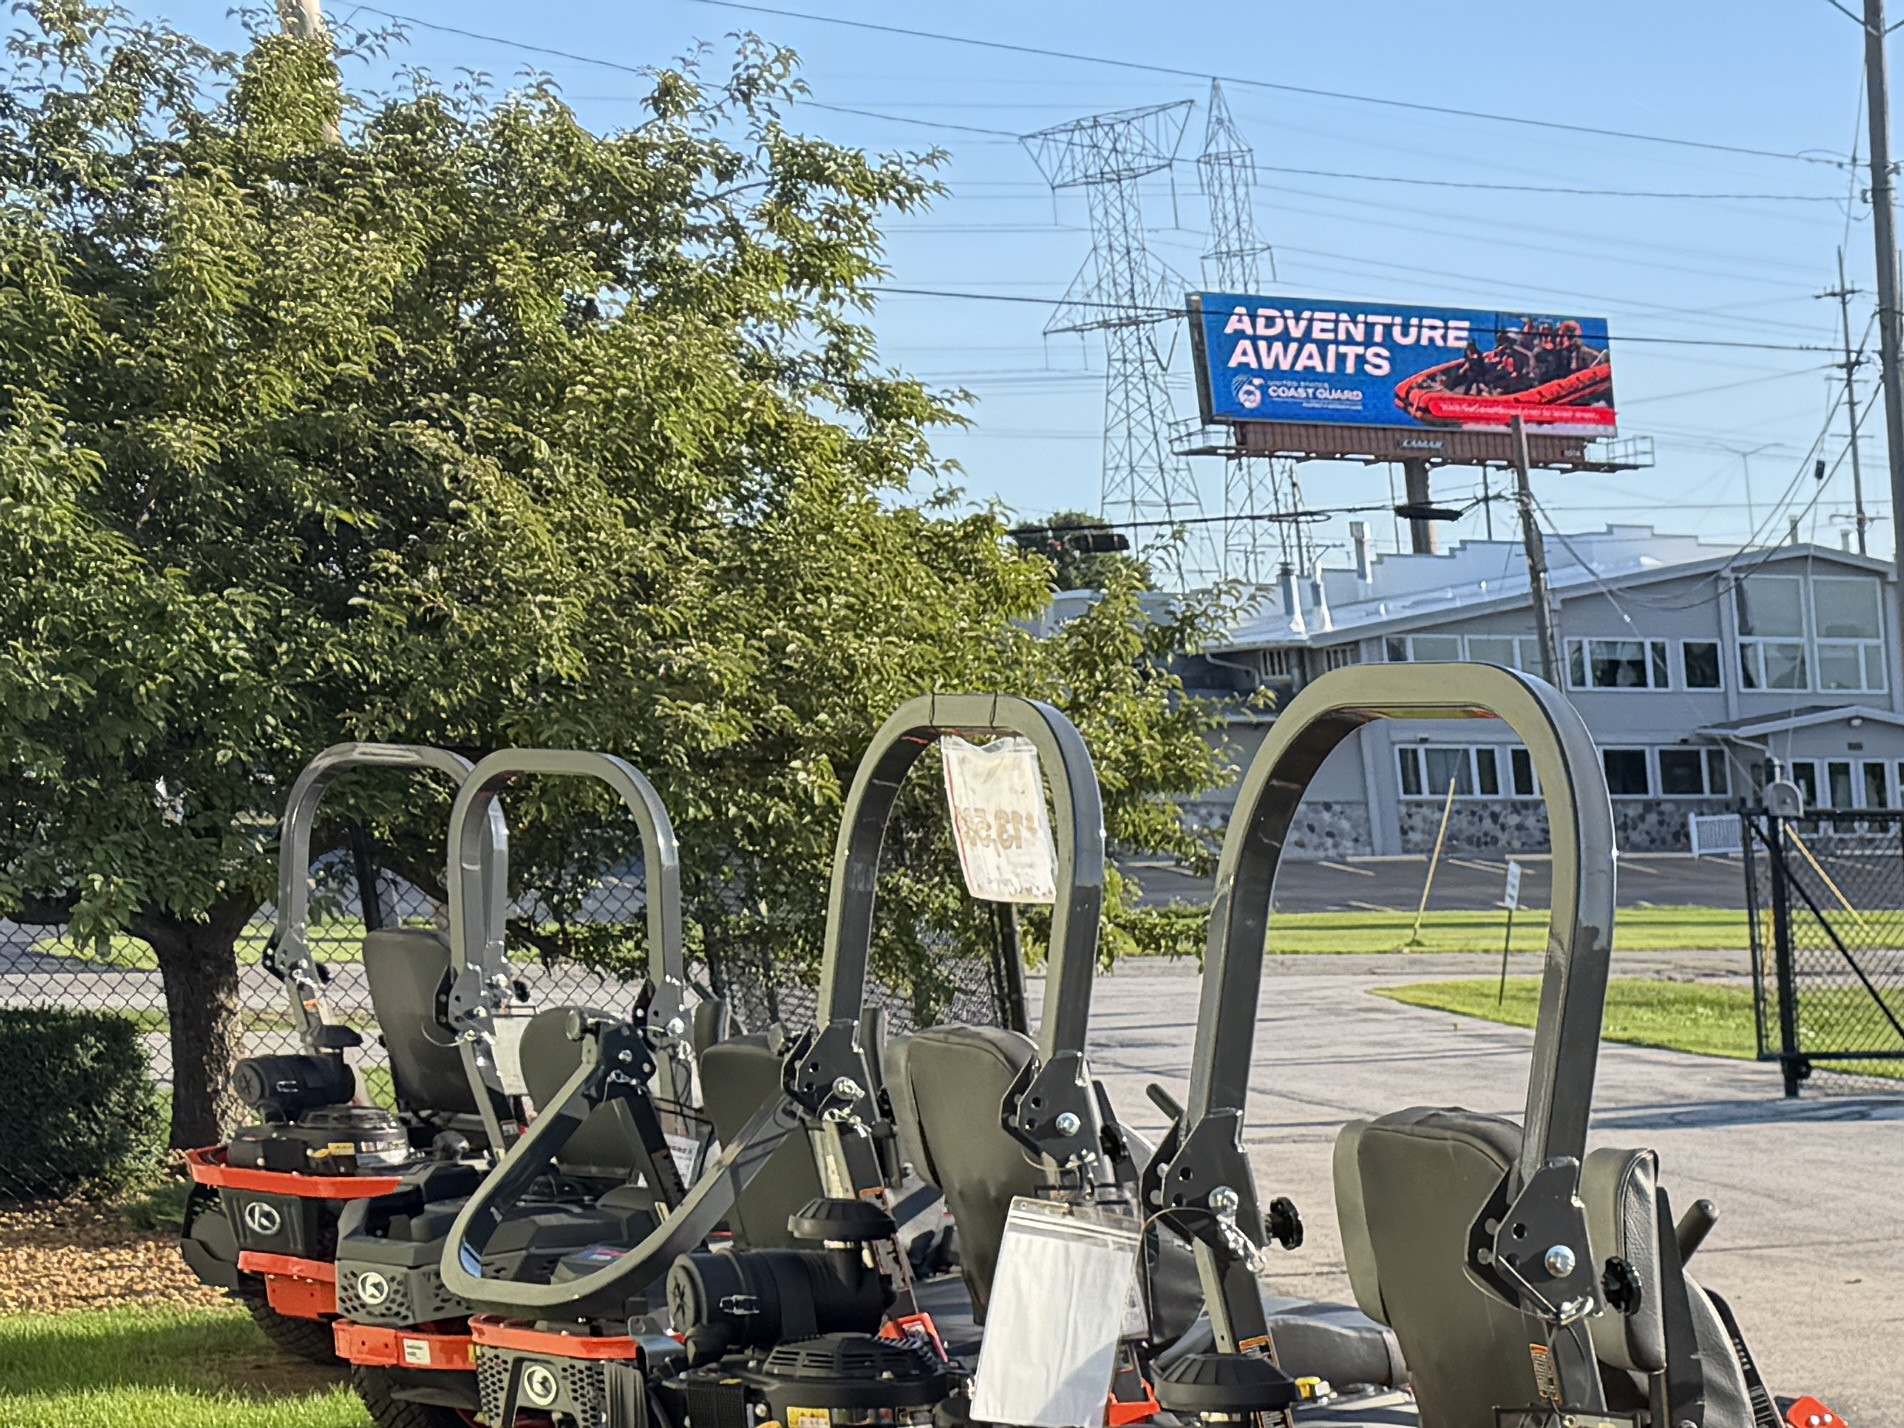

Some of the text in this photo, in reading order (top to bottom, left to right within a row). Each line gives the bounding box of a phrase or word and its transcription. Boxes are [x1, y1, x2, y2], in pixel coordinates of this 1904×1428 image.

[1225, 306, 1470, 348] ADVENTURE
[1228, 339, 1391, 377] AWAITS
[1268, 386, 1363, 401] COAST GUARD
